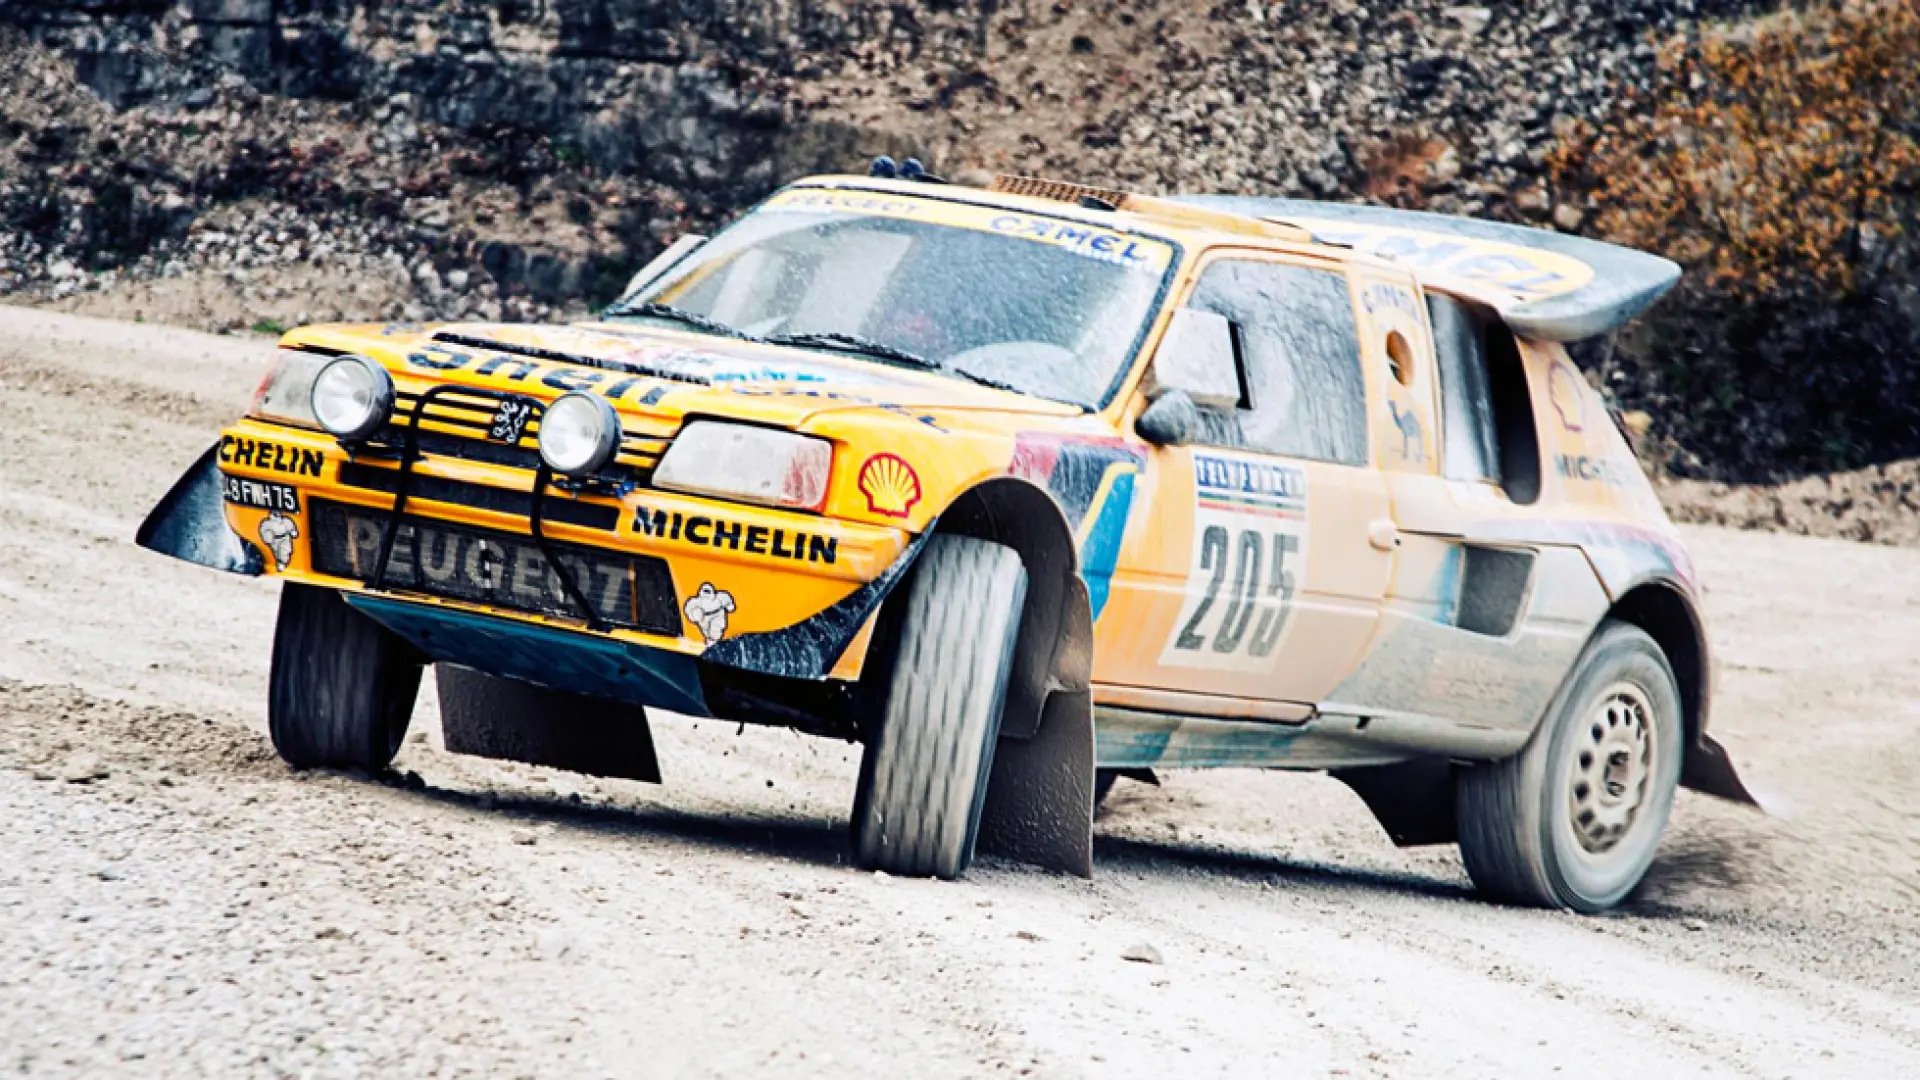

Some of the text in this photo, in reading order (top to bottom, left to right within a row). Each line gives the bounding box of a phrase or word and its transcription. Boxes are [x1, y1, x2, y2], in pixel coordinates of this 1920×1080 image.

[991, 215, 1150, 262] CAMEL
[272, 486, 297, 511] 75
[347, 516, 609, 613] PEUGEOT
[632, 504, 838, 565] MICHELIN
[1174, 524, 1300, 658] 205
